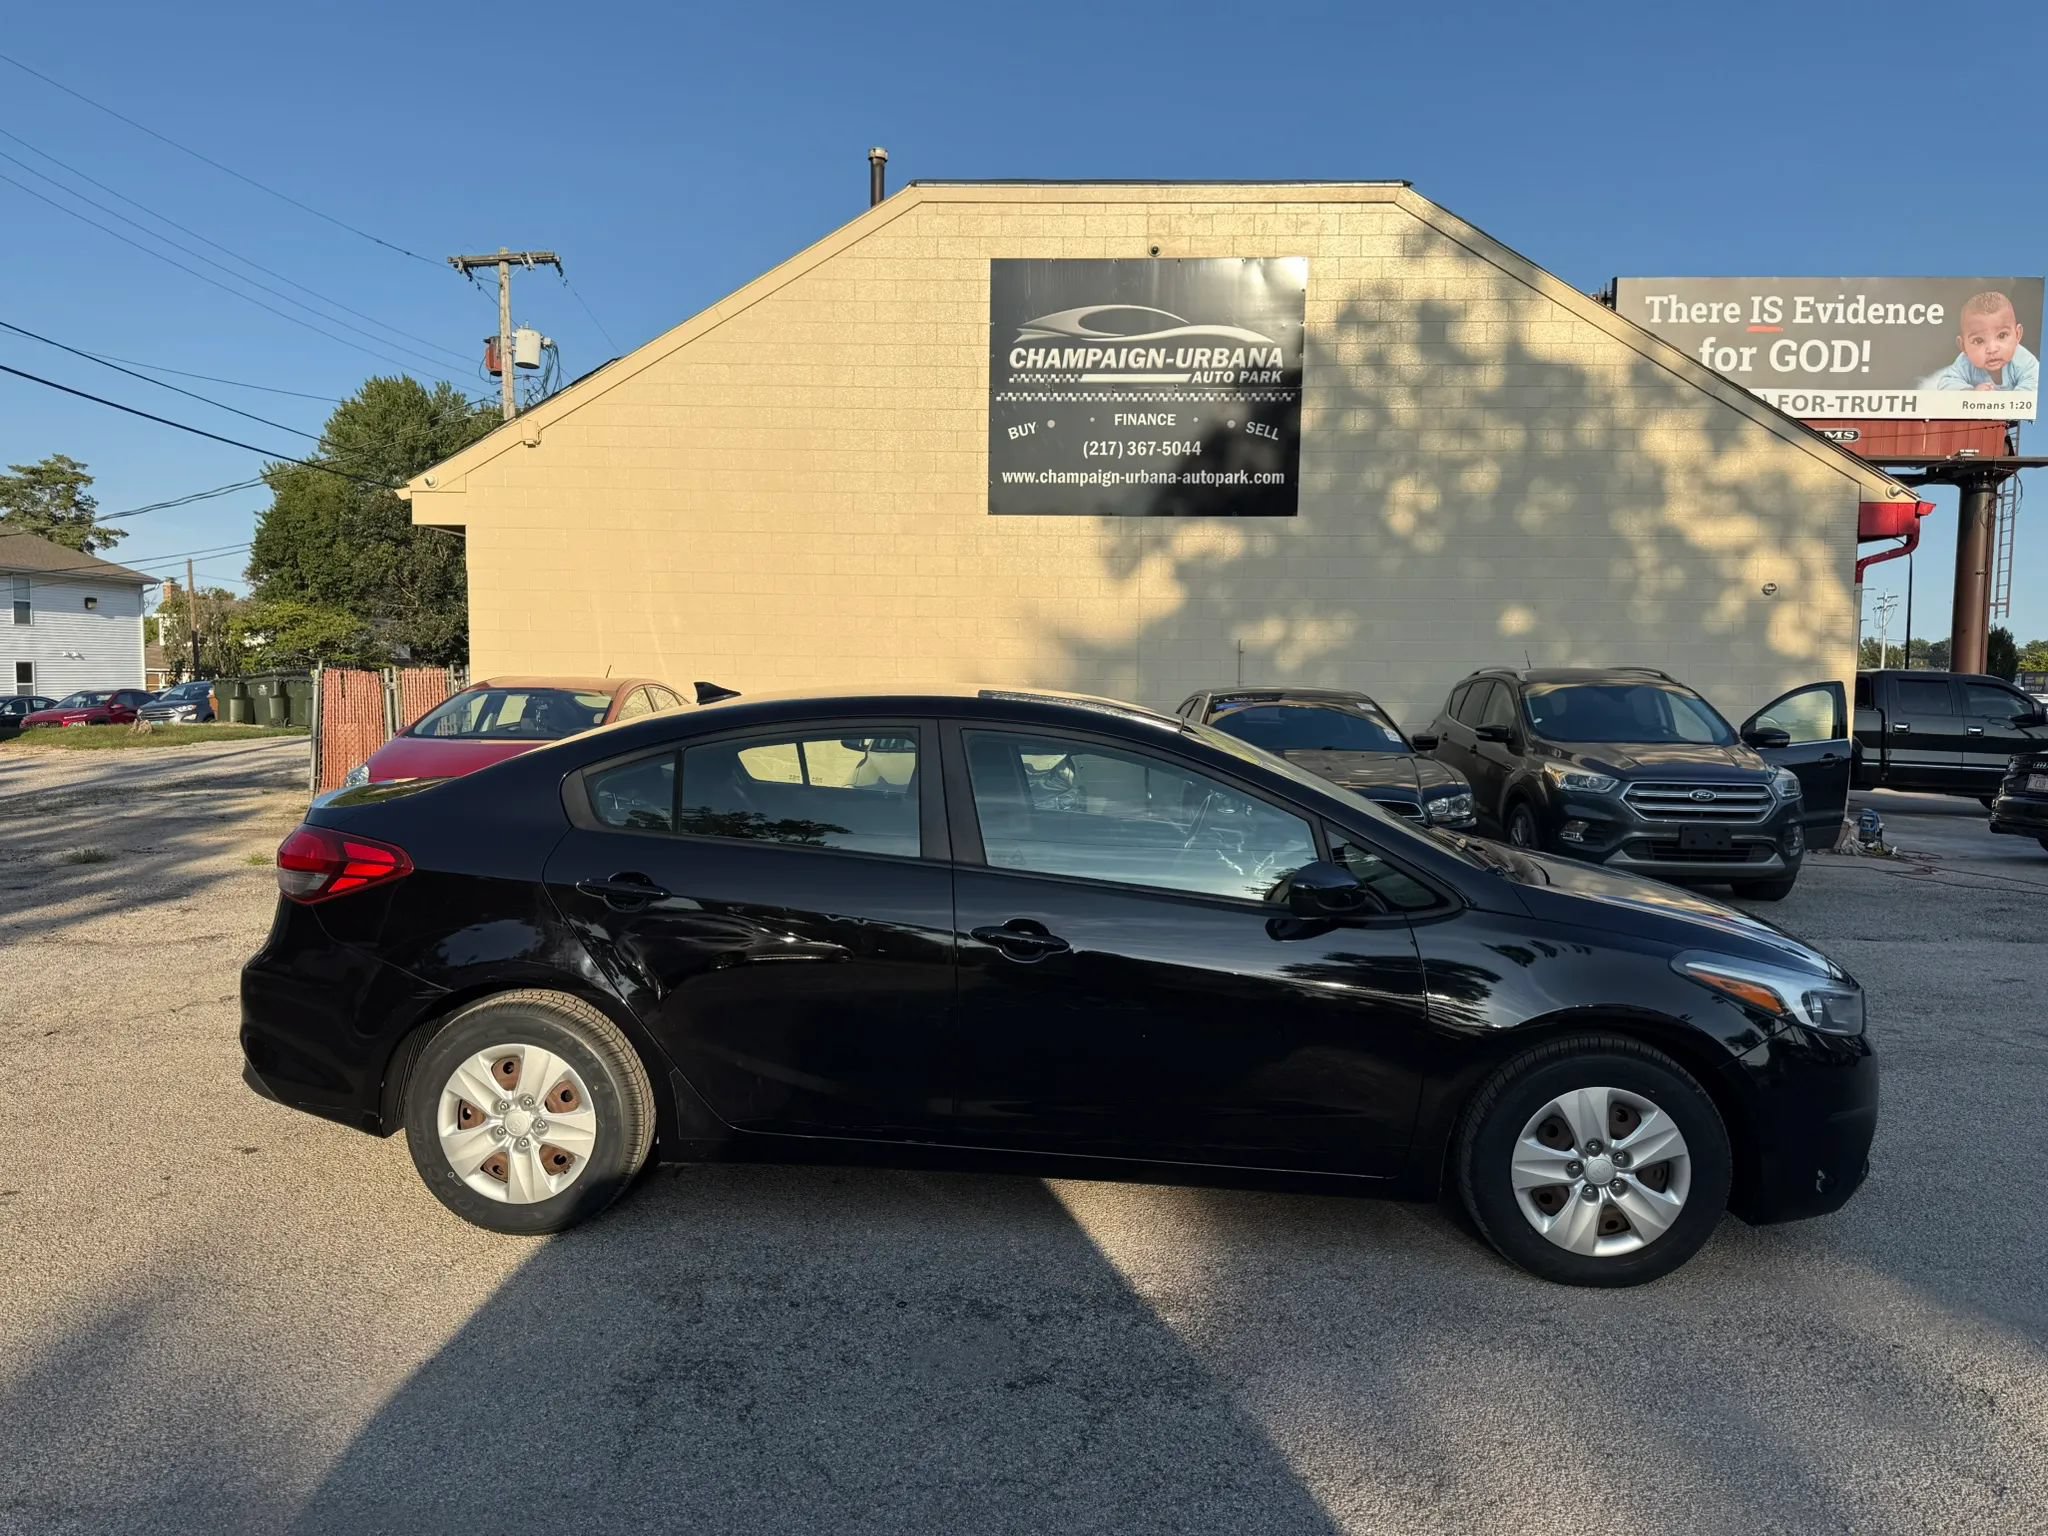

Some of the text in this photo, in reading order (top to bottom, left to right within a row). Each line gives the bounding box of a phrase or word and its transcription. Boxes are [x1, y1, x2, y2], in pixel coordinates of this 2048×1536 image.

[1645, 294, 1944, 325] There IS Evidence
[1009, 348, 1284, 368] CHAMPAIGN-URBANA
[1699, 337, 1871, 373] for GOD!
[1191, 371, 1282, 383] AUTO PARK
[1962, 401, 2032, 410] Romans 1:20
[1008, 413, 1280, 440] BUY FINANCE SELL
[1083, 441, 1202, 459] (217) 367-5044
[1002, 468, 1284, 486] www.champaign-urbana-autopark.com
